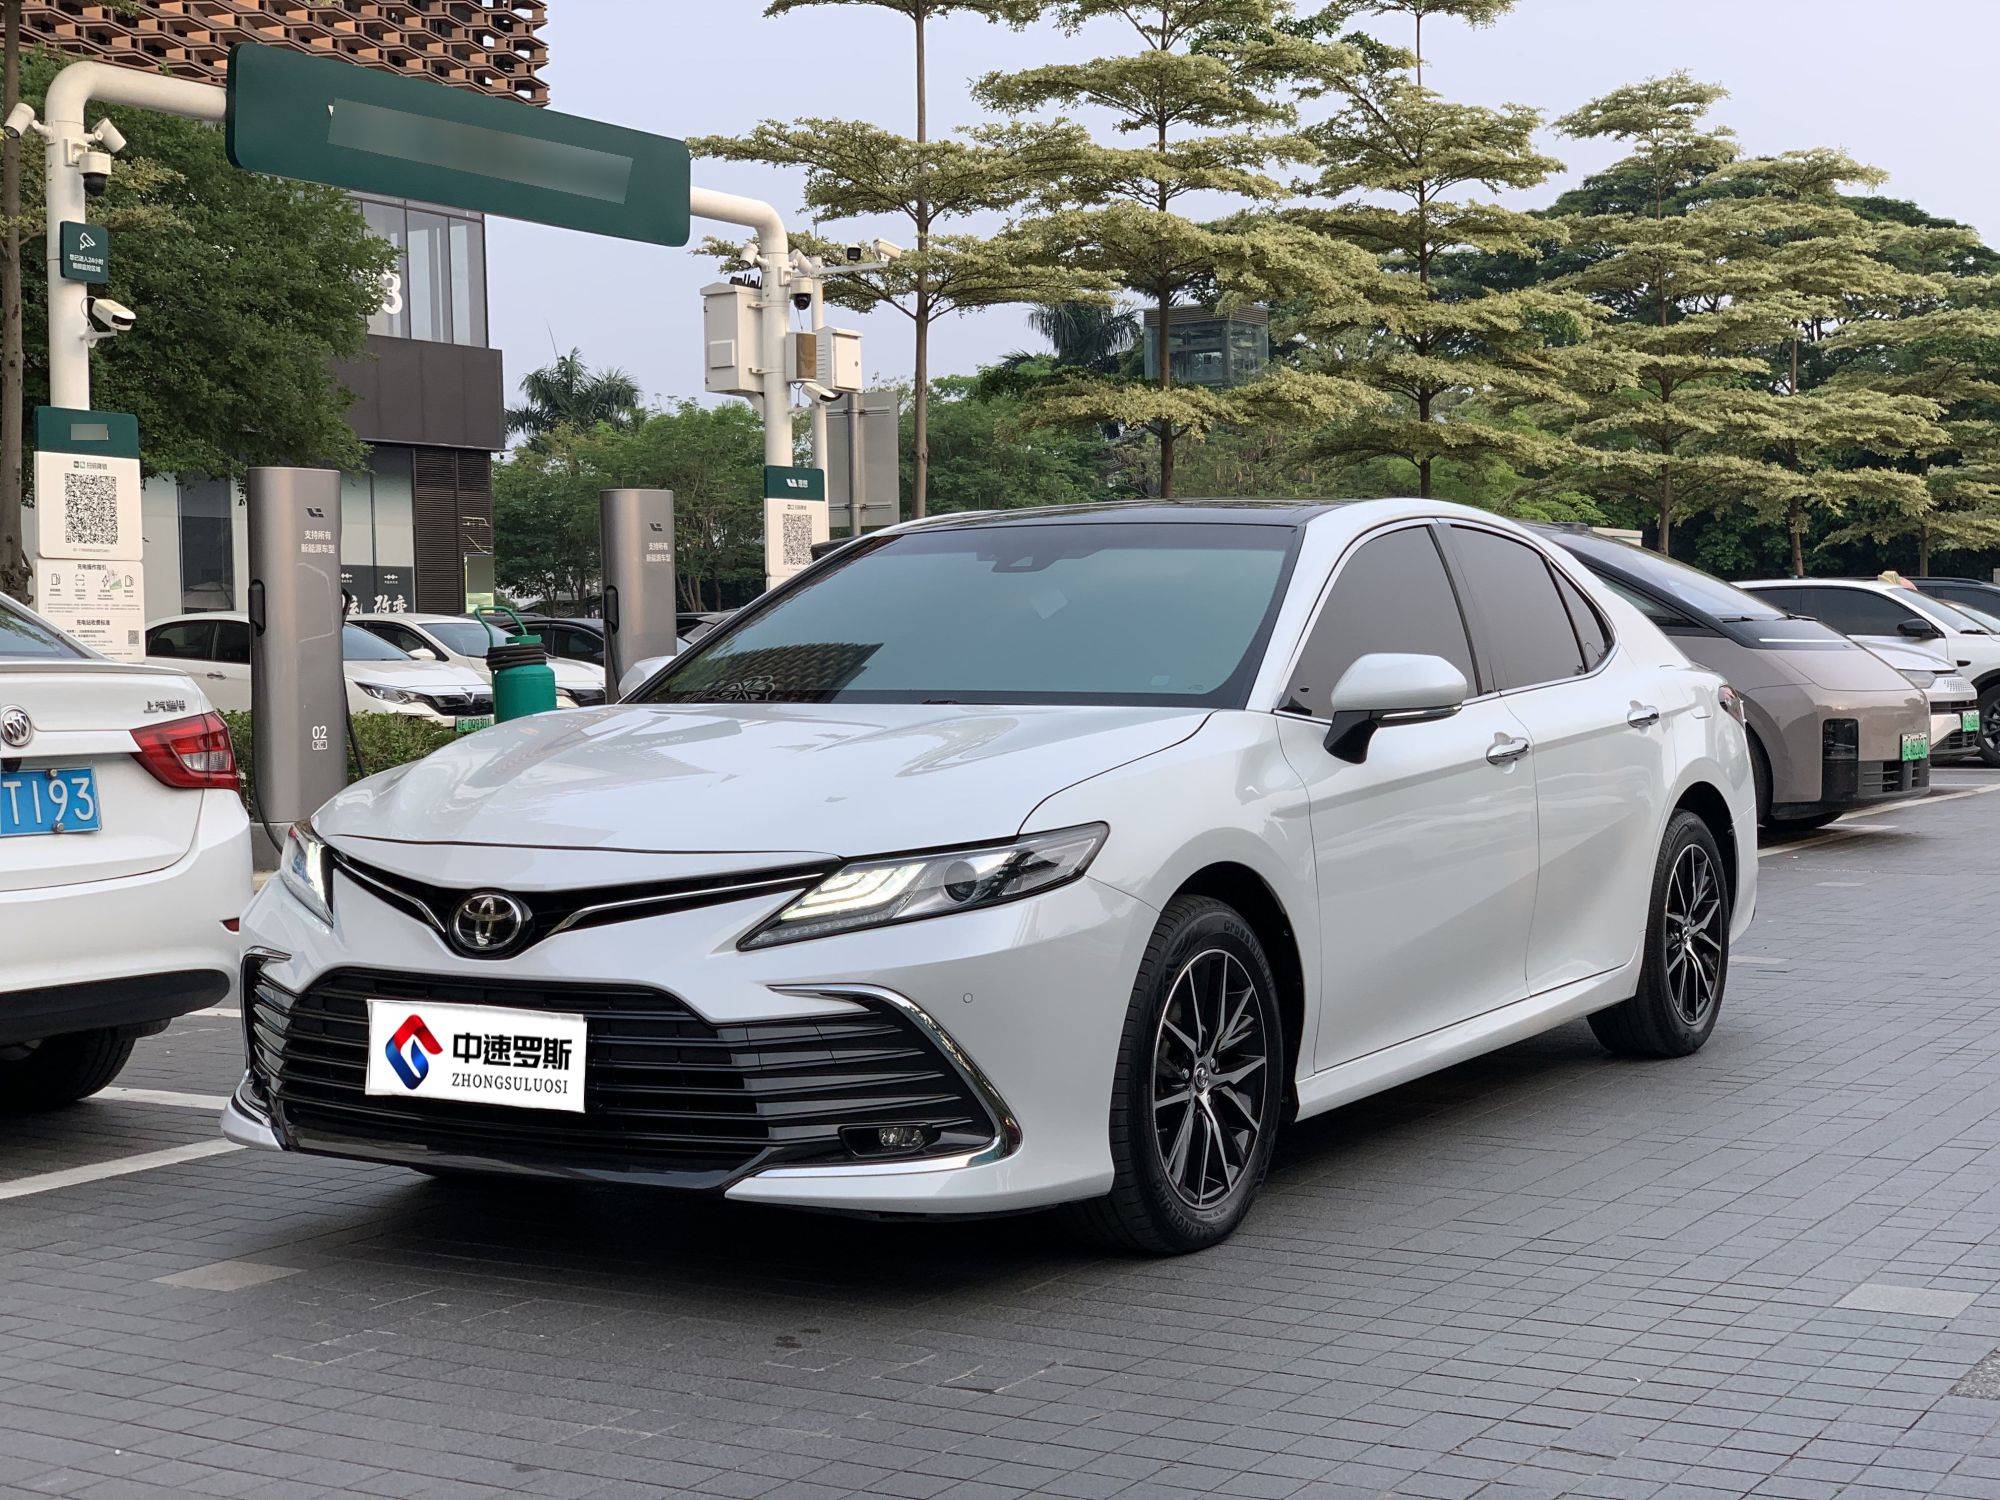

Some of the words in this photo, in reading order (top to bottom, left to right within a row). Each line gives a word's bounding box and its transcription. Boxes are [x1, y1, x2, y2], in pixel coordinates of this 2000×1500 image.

[304, 530, 332, 540] 支持所有
[300, 543, 336, 554] 新能源车型
[312, 725, 327, 739] 02
